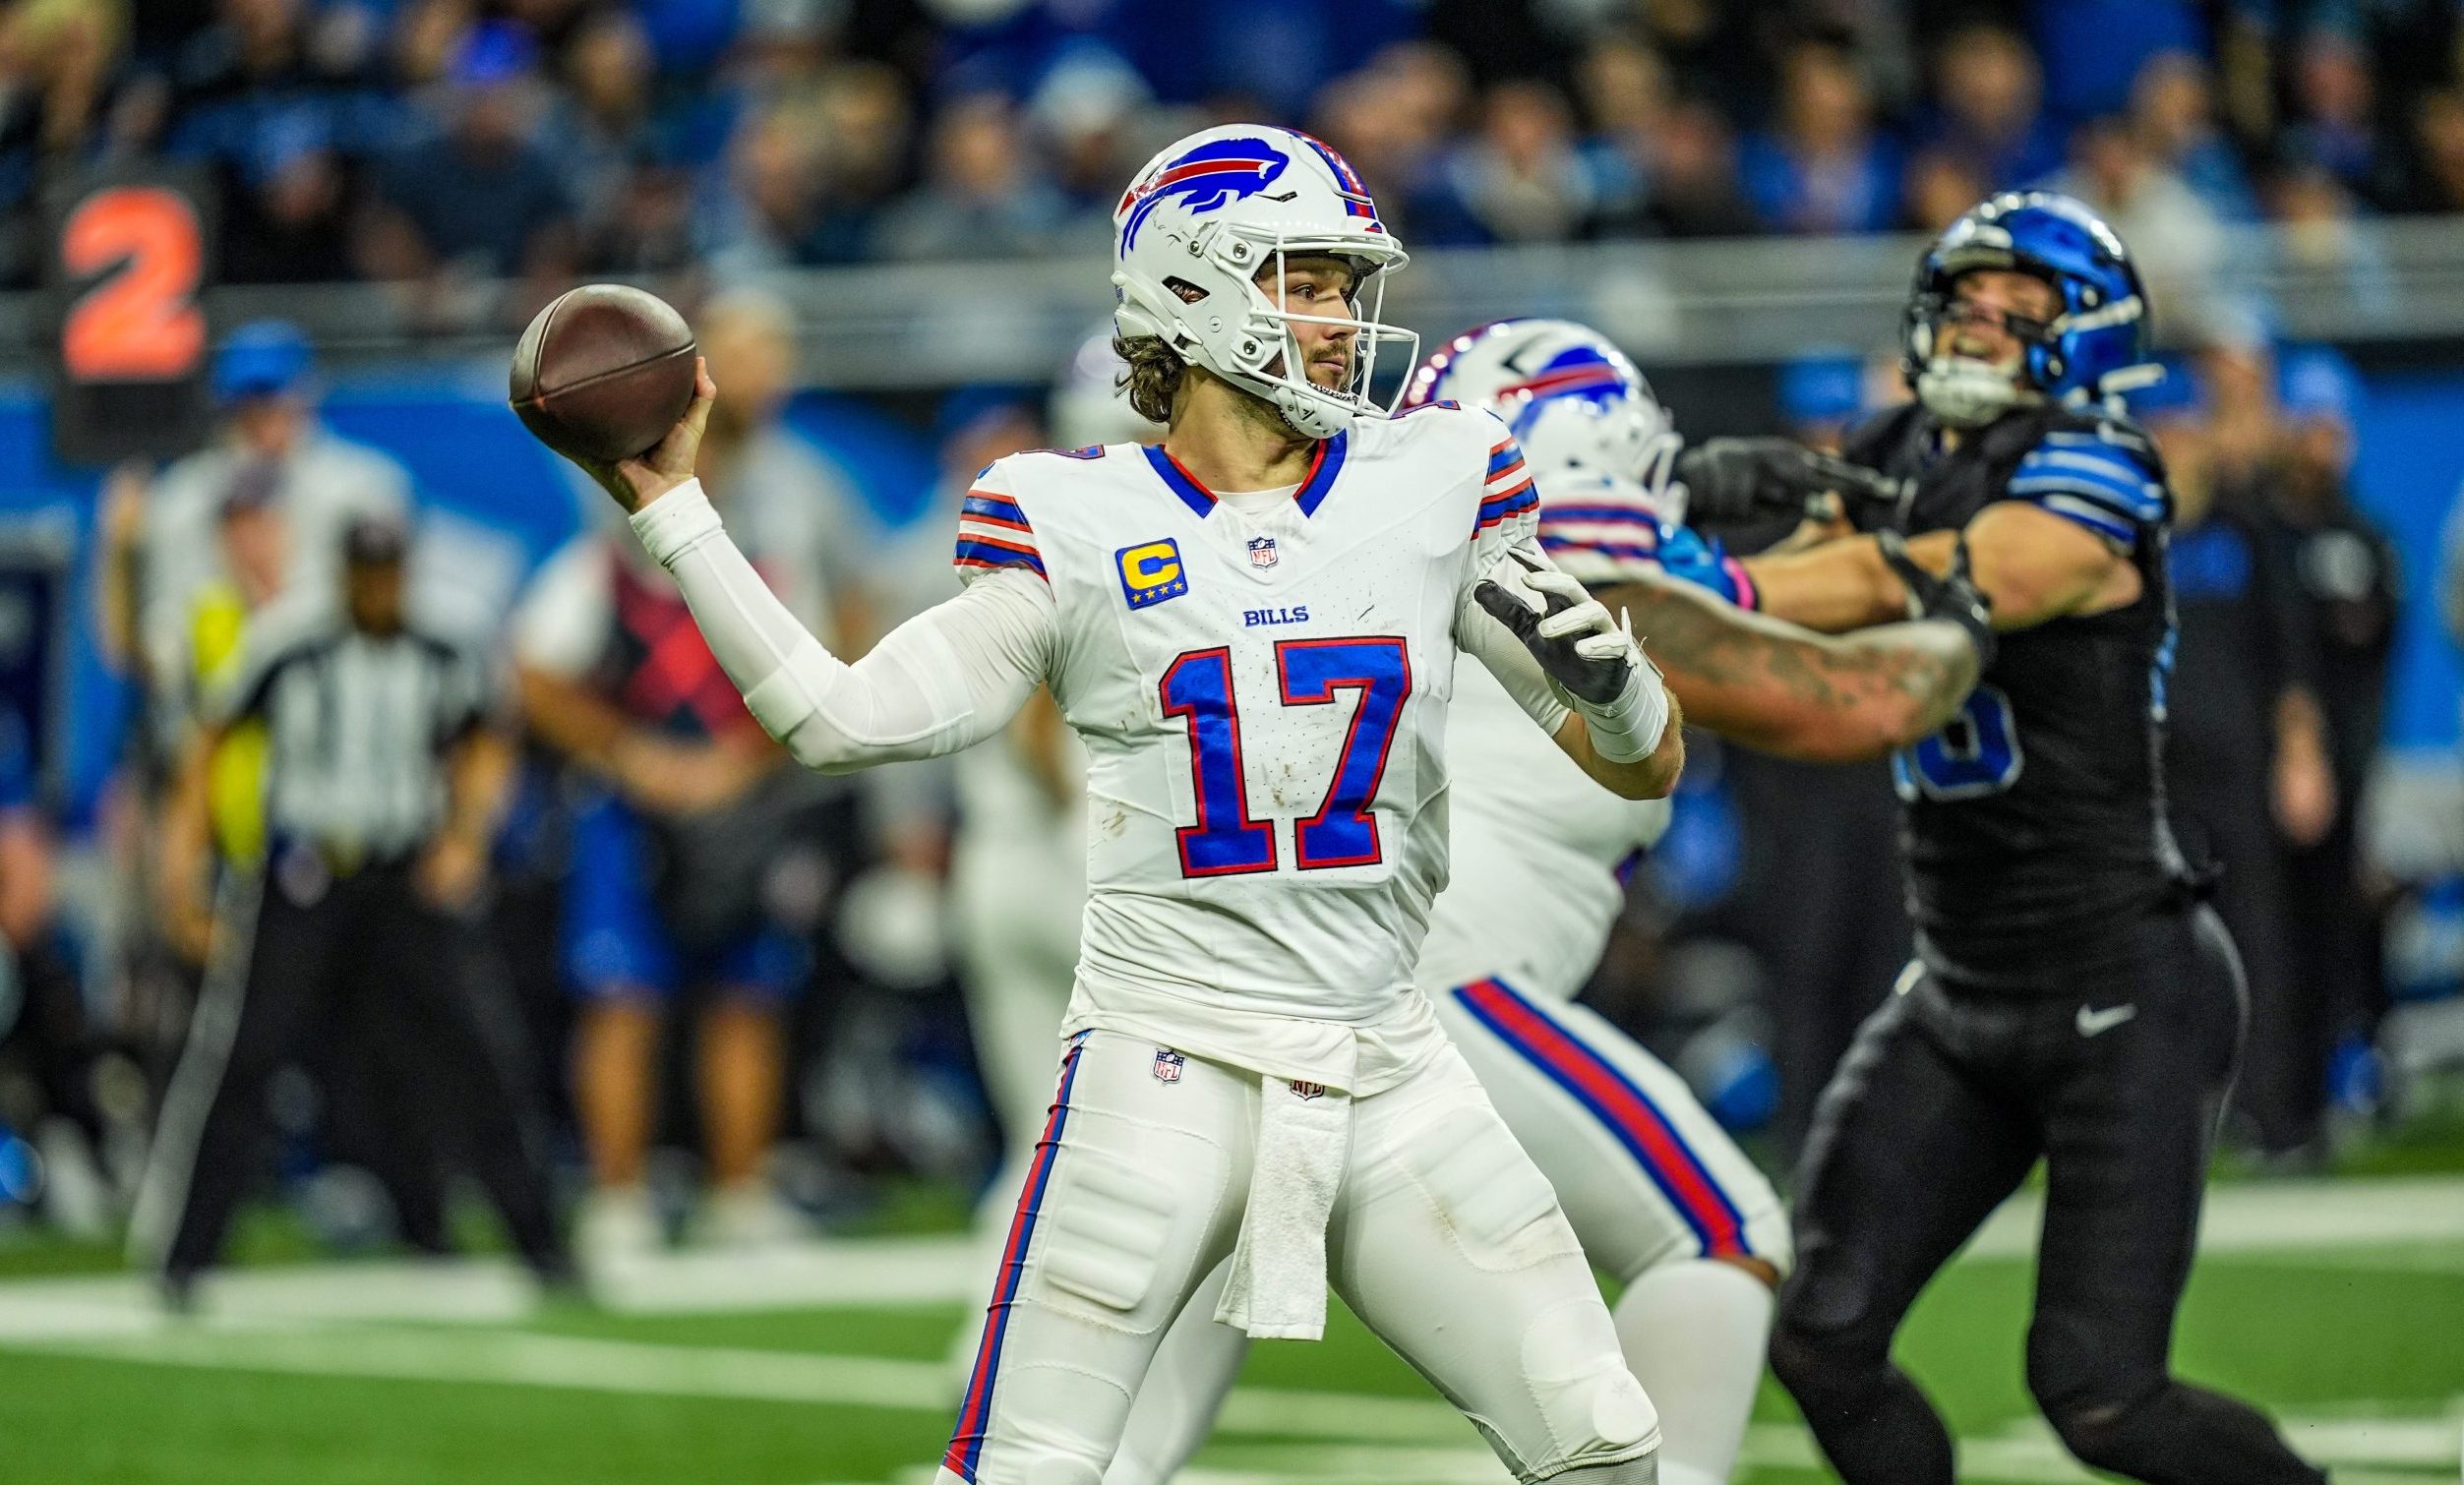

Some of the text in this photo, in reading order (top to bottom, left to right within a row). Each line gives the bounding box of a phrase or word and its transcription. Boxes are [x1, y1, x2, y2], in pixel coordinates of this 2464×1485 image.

[62, 185, 206, 381] 2
[1121, 543, 1180, 590] C
[1243, 606, 1309, 626] BILLS
[1159, 635, 1412, 878] 17
[1155, 1061, 1178, 1080] NFL
